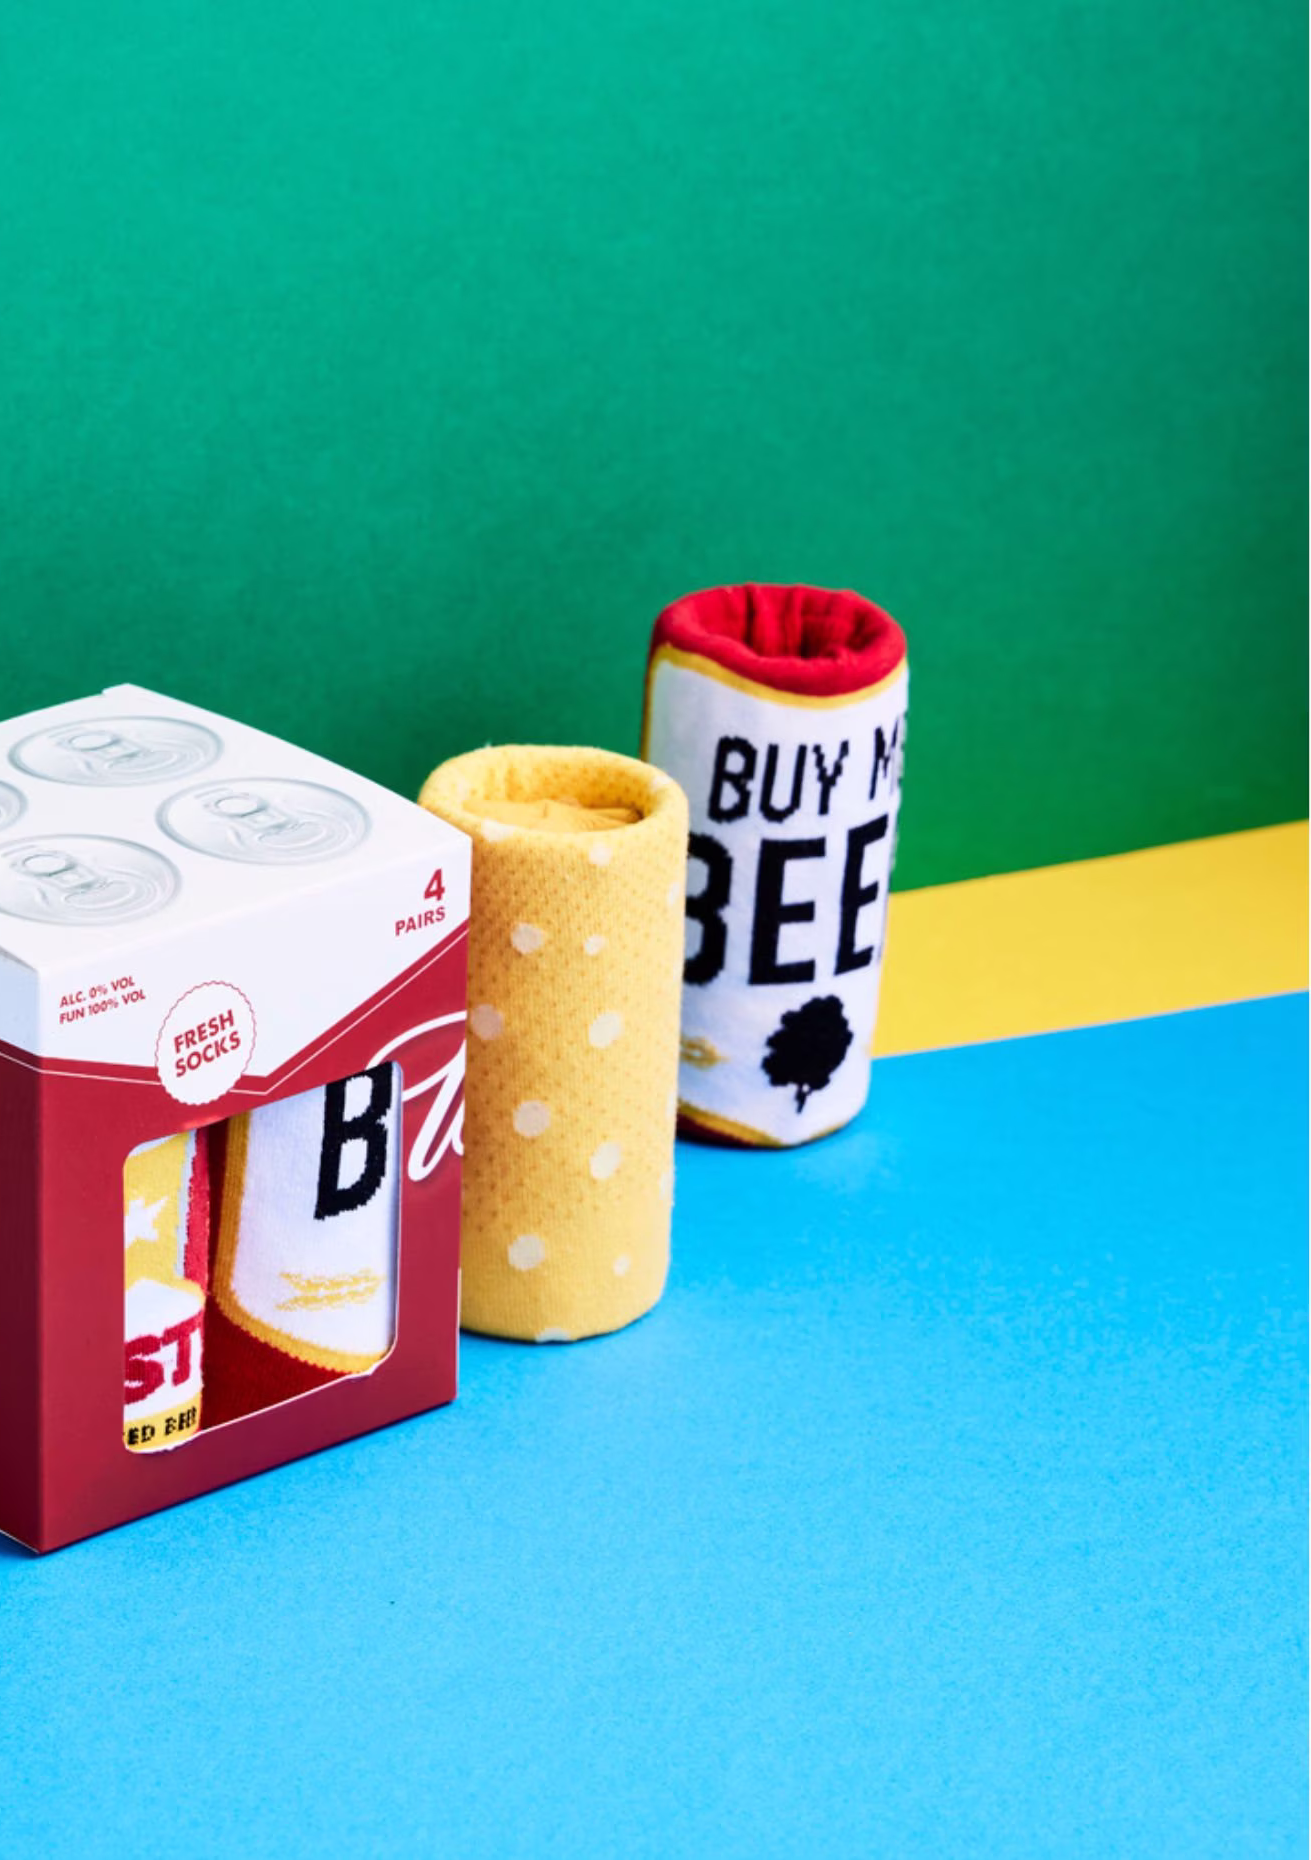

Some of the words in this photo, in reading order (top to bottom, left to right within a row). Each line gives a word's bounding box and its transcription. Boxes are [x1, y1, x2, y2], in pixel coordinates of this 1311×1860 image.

[708, 735, 849, 824] BUY
[424, 868, 445, 901] 4
[395, 906, 445, 936] PAIRS
[59, 1007, 85, 1024] FUN
[88, 999, 119, 1015] 100%
[121, 989, 146, 1005] VOL
[60, 990, 86, 1008] ALC.
[89, 985, 107, 999] 0%
[111, 976, 135, 991] VOL
[174, 1009, 234, 1053] FRESH
[175, 1031, 240, 1077] SOCKS
